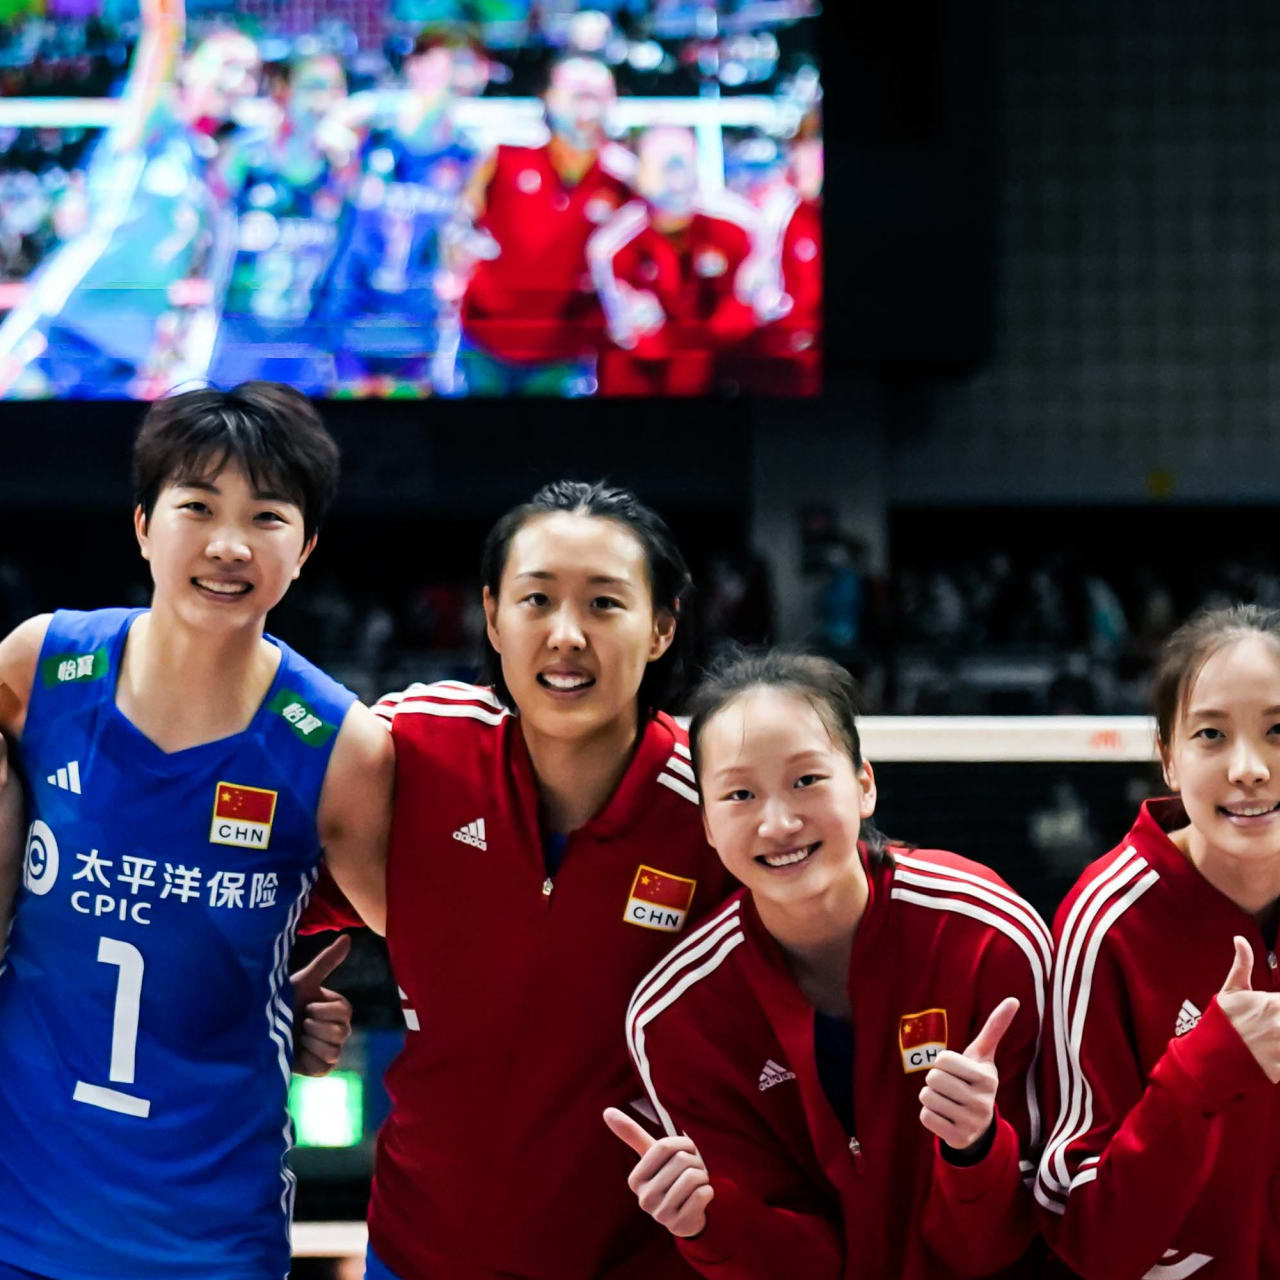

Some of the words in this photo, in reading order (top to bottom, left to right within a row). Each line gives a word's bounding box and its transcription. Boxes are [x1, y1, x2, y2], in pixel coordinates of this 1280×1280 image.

[219, 824, 264, 843] CHN
[72, 849, 280, 910] 太平洋保险
[70, 890, 152, 925] CPIC
[633, 906, 679, 928] CHN
[910, 1049, 938, 1066] CH
